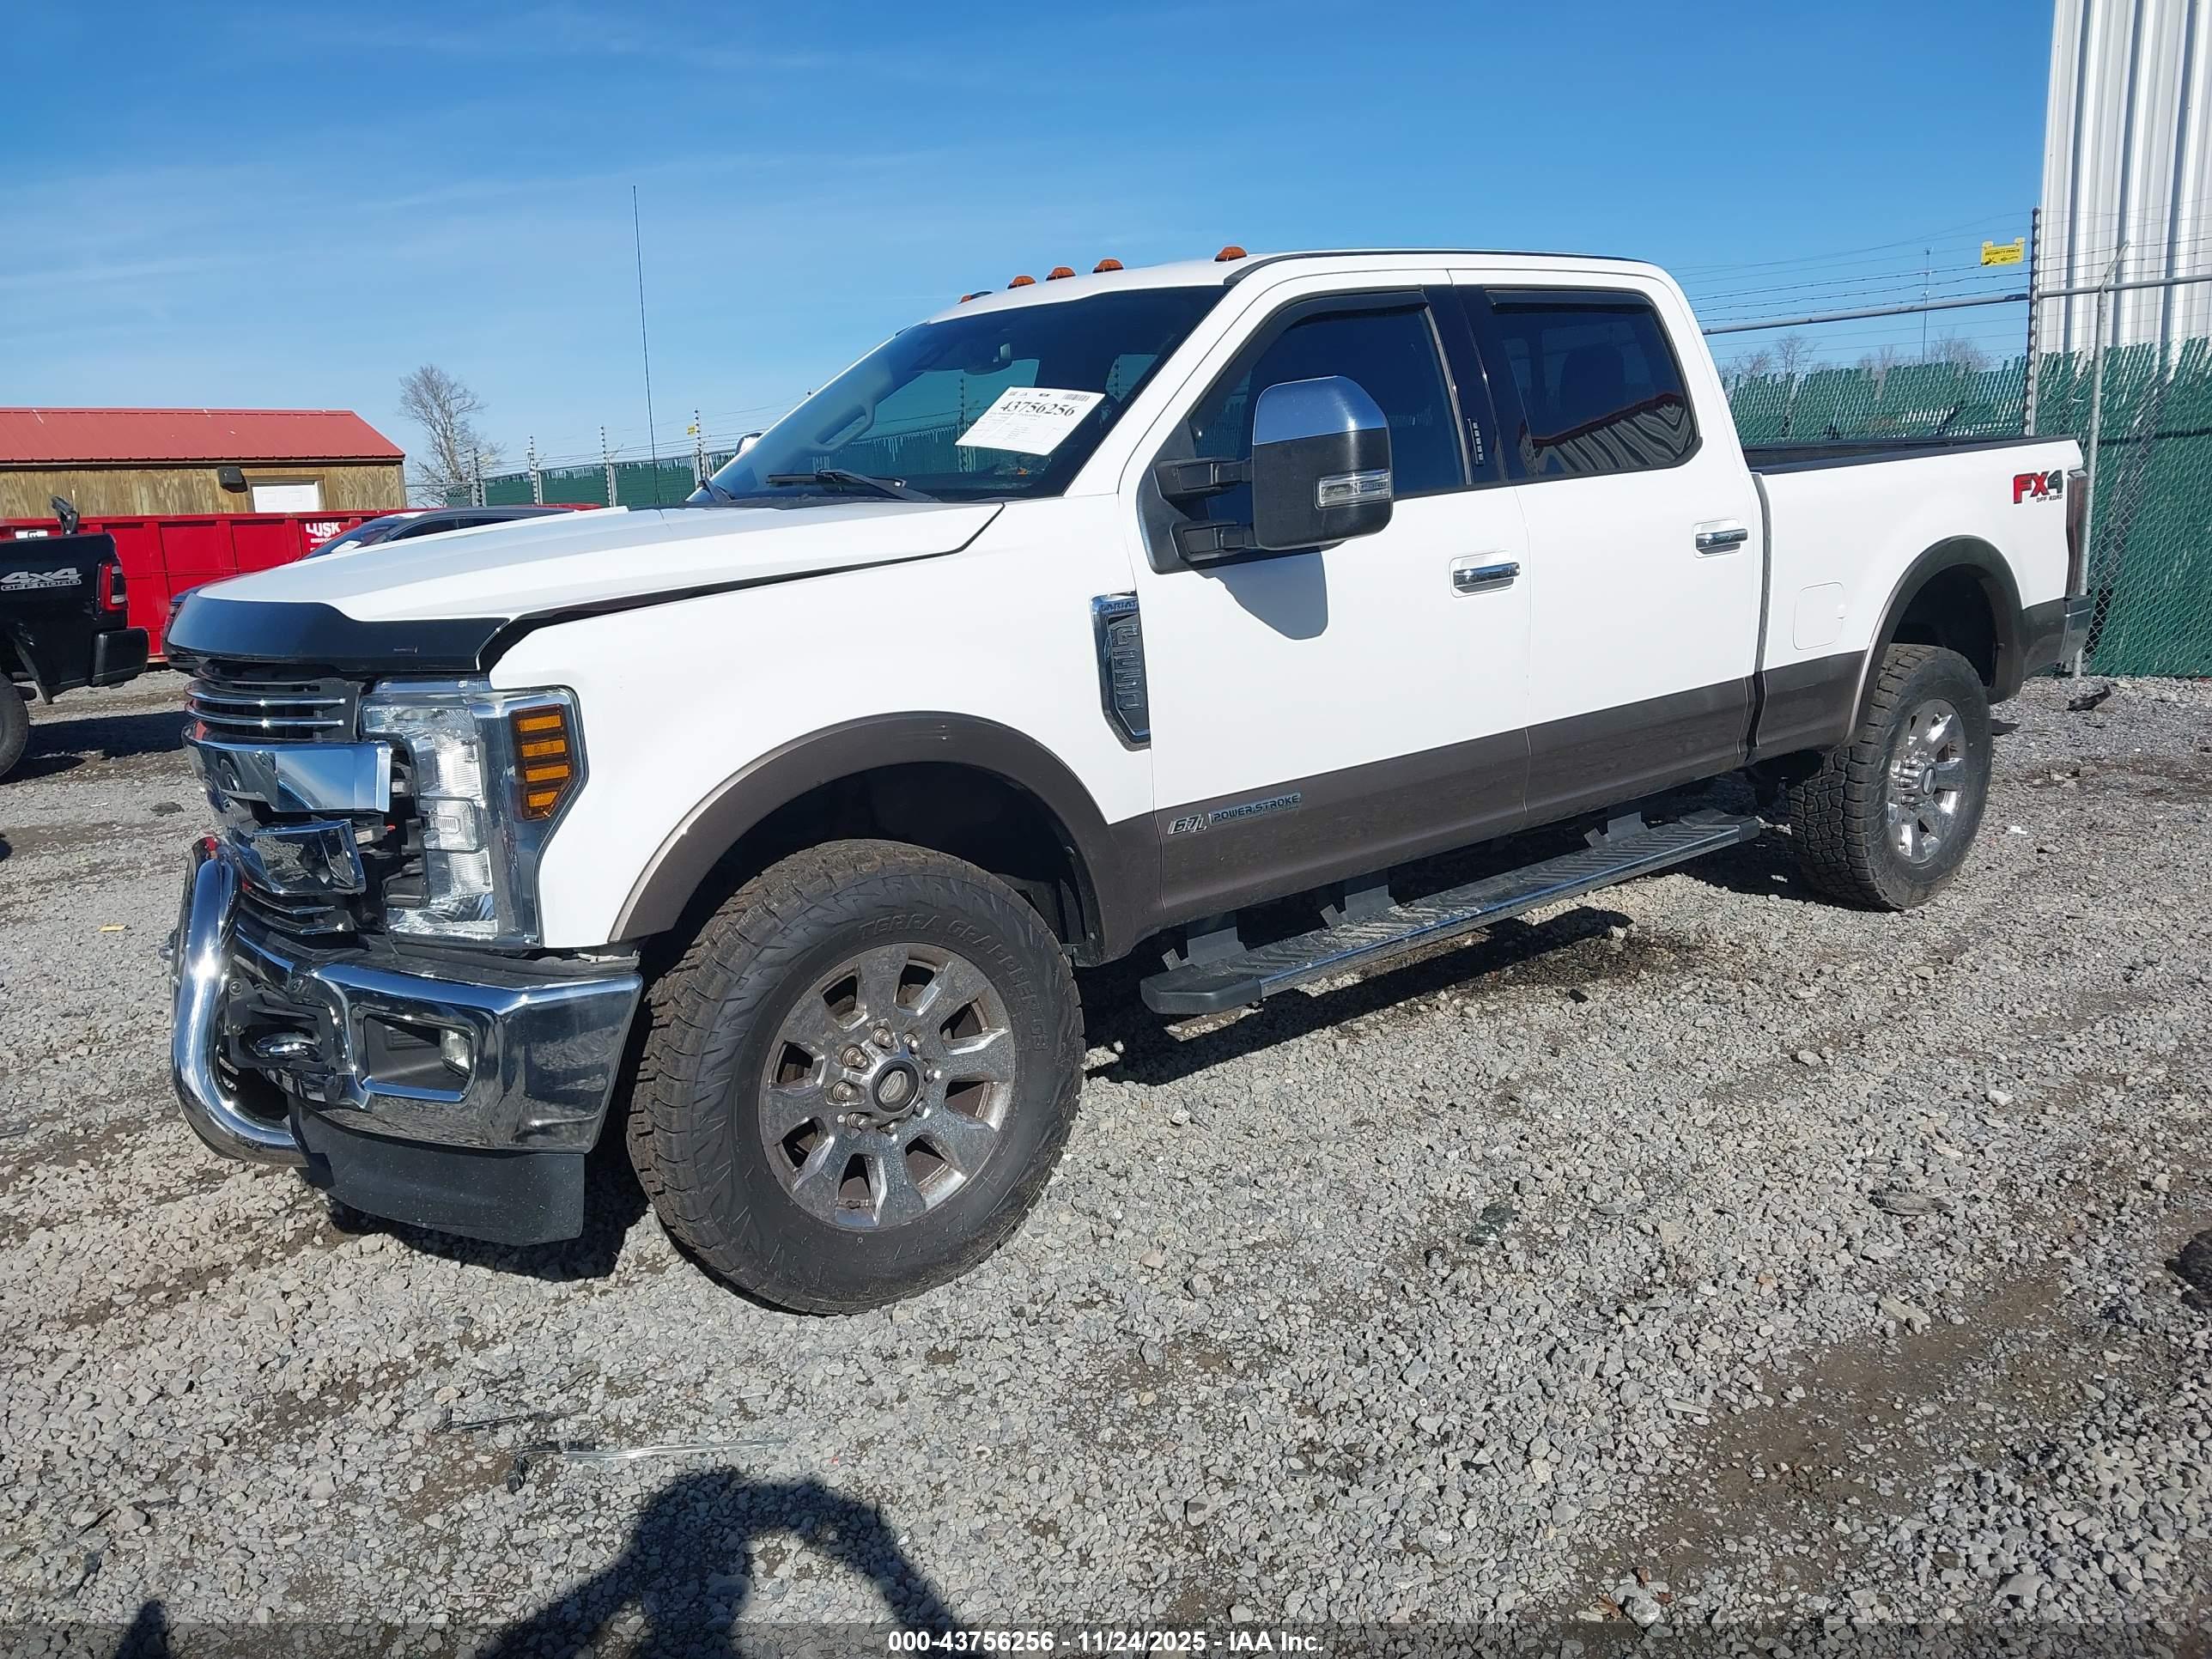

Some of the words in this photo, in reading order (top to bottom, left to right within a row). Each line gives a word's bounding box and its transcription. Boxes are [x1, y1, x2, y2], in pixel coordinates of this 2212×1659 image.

[1000, 401, 1079, 416] 43756256
[2013, 469, 2064, 504] FX4
[305, 521, 342, 538] LUSK
[1212, 805, 1254, 823] POWER
[1254, 794, 1301, 812] STROKE
